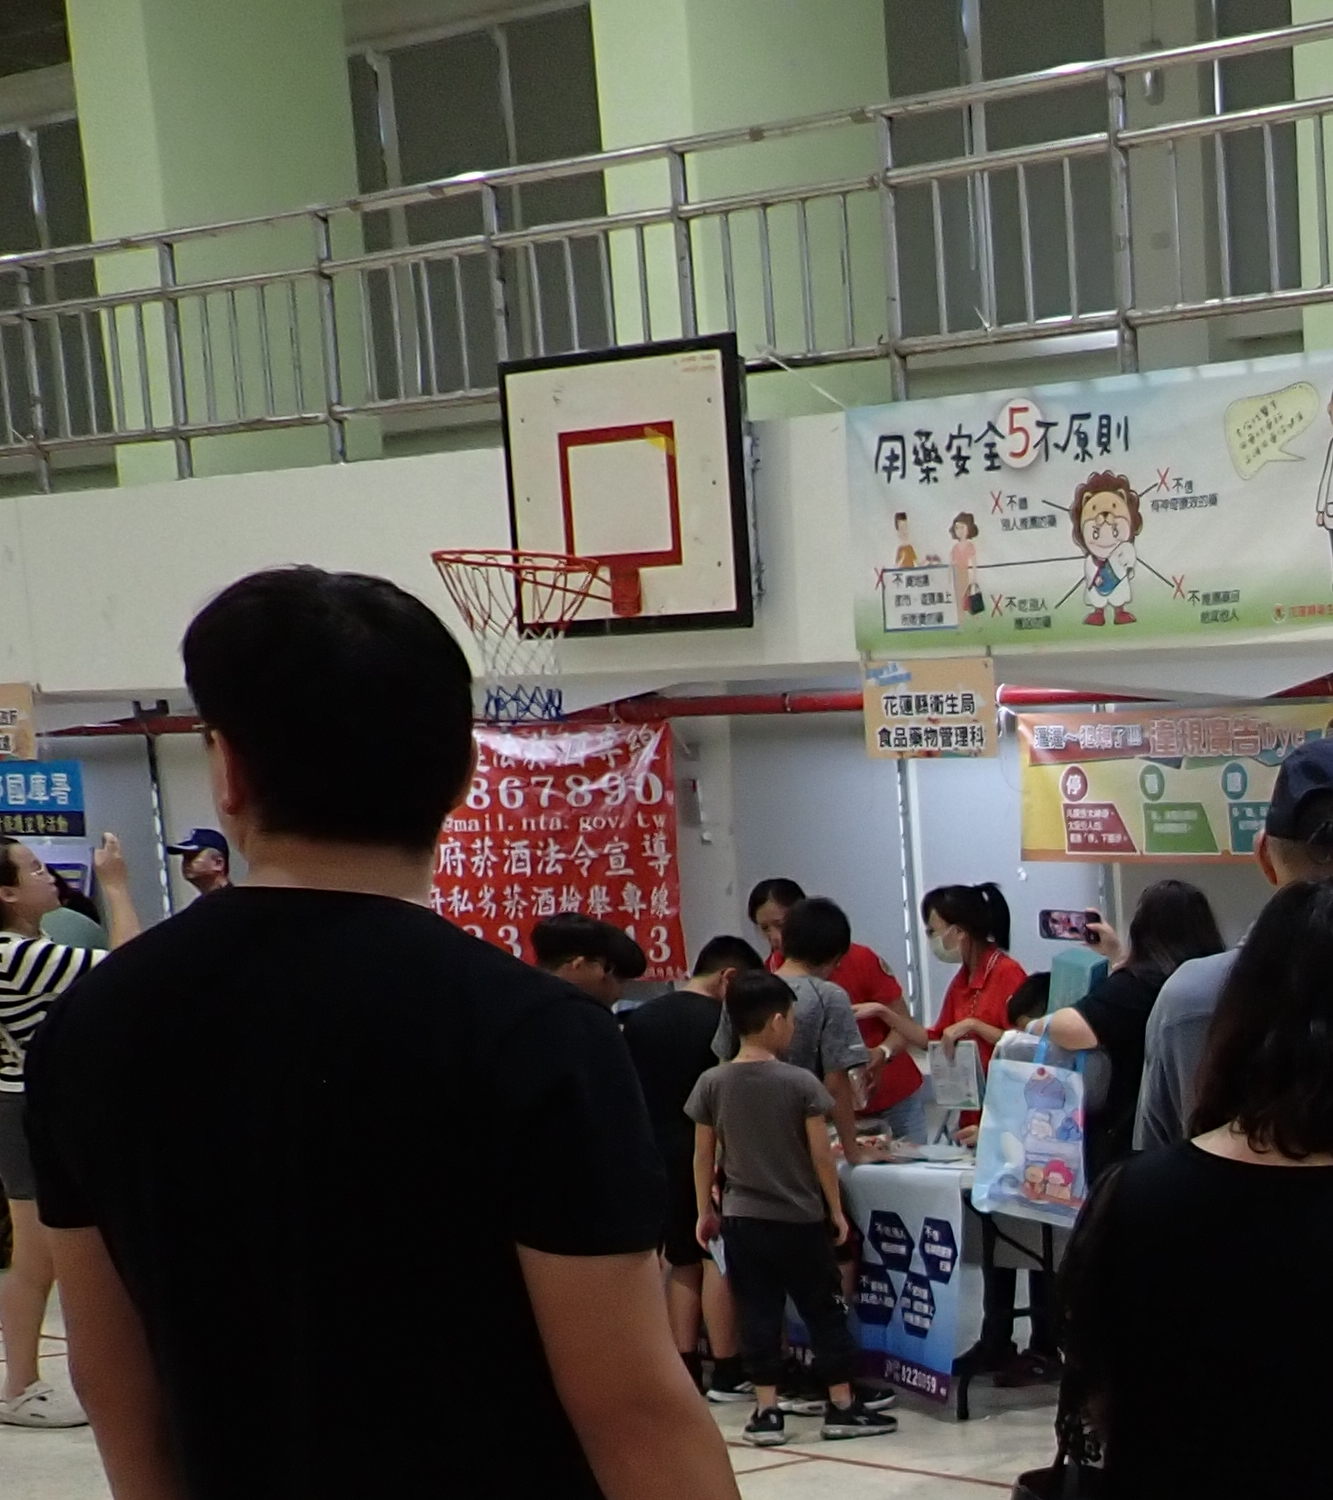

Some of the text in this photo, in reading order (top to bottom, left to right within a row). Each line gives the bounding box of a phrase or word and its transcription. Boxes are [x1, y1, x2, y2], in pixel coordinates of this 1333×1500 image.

[874, 406, 1129, 485] 用藥安全5不原則
[883, 693, 976, 716] 花蓮縣衛生局
[878, 725, 985, 748] 食品藥物管理科
